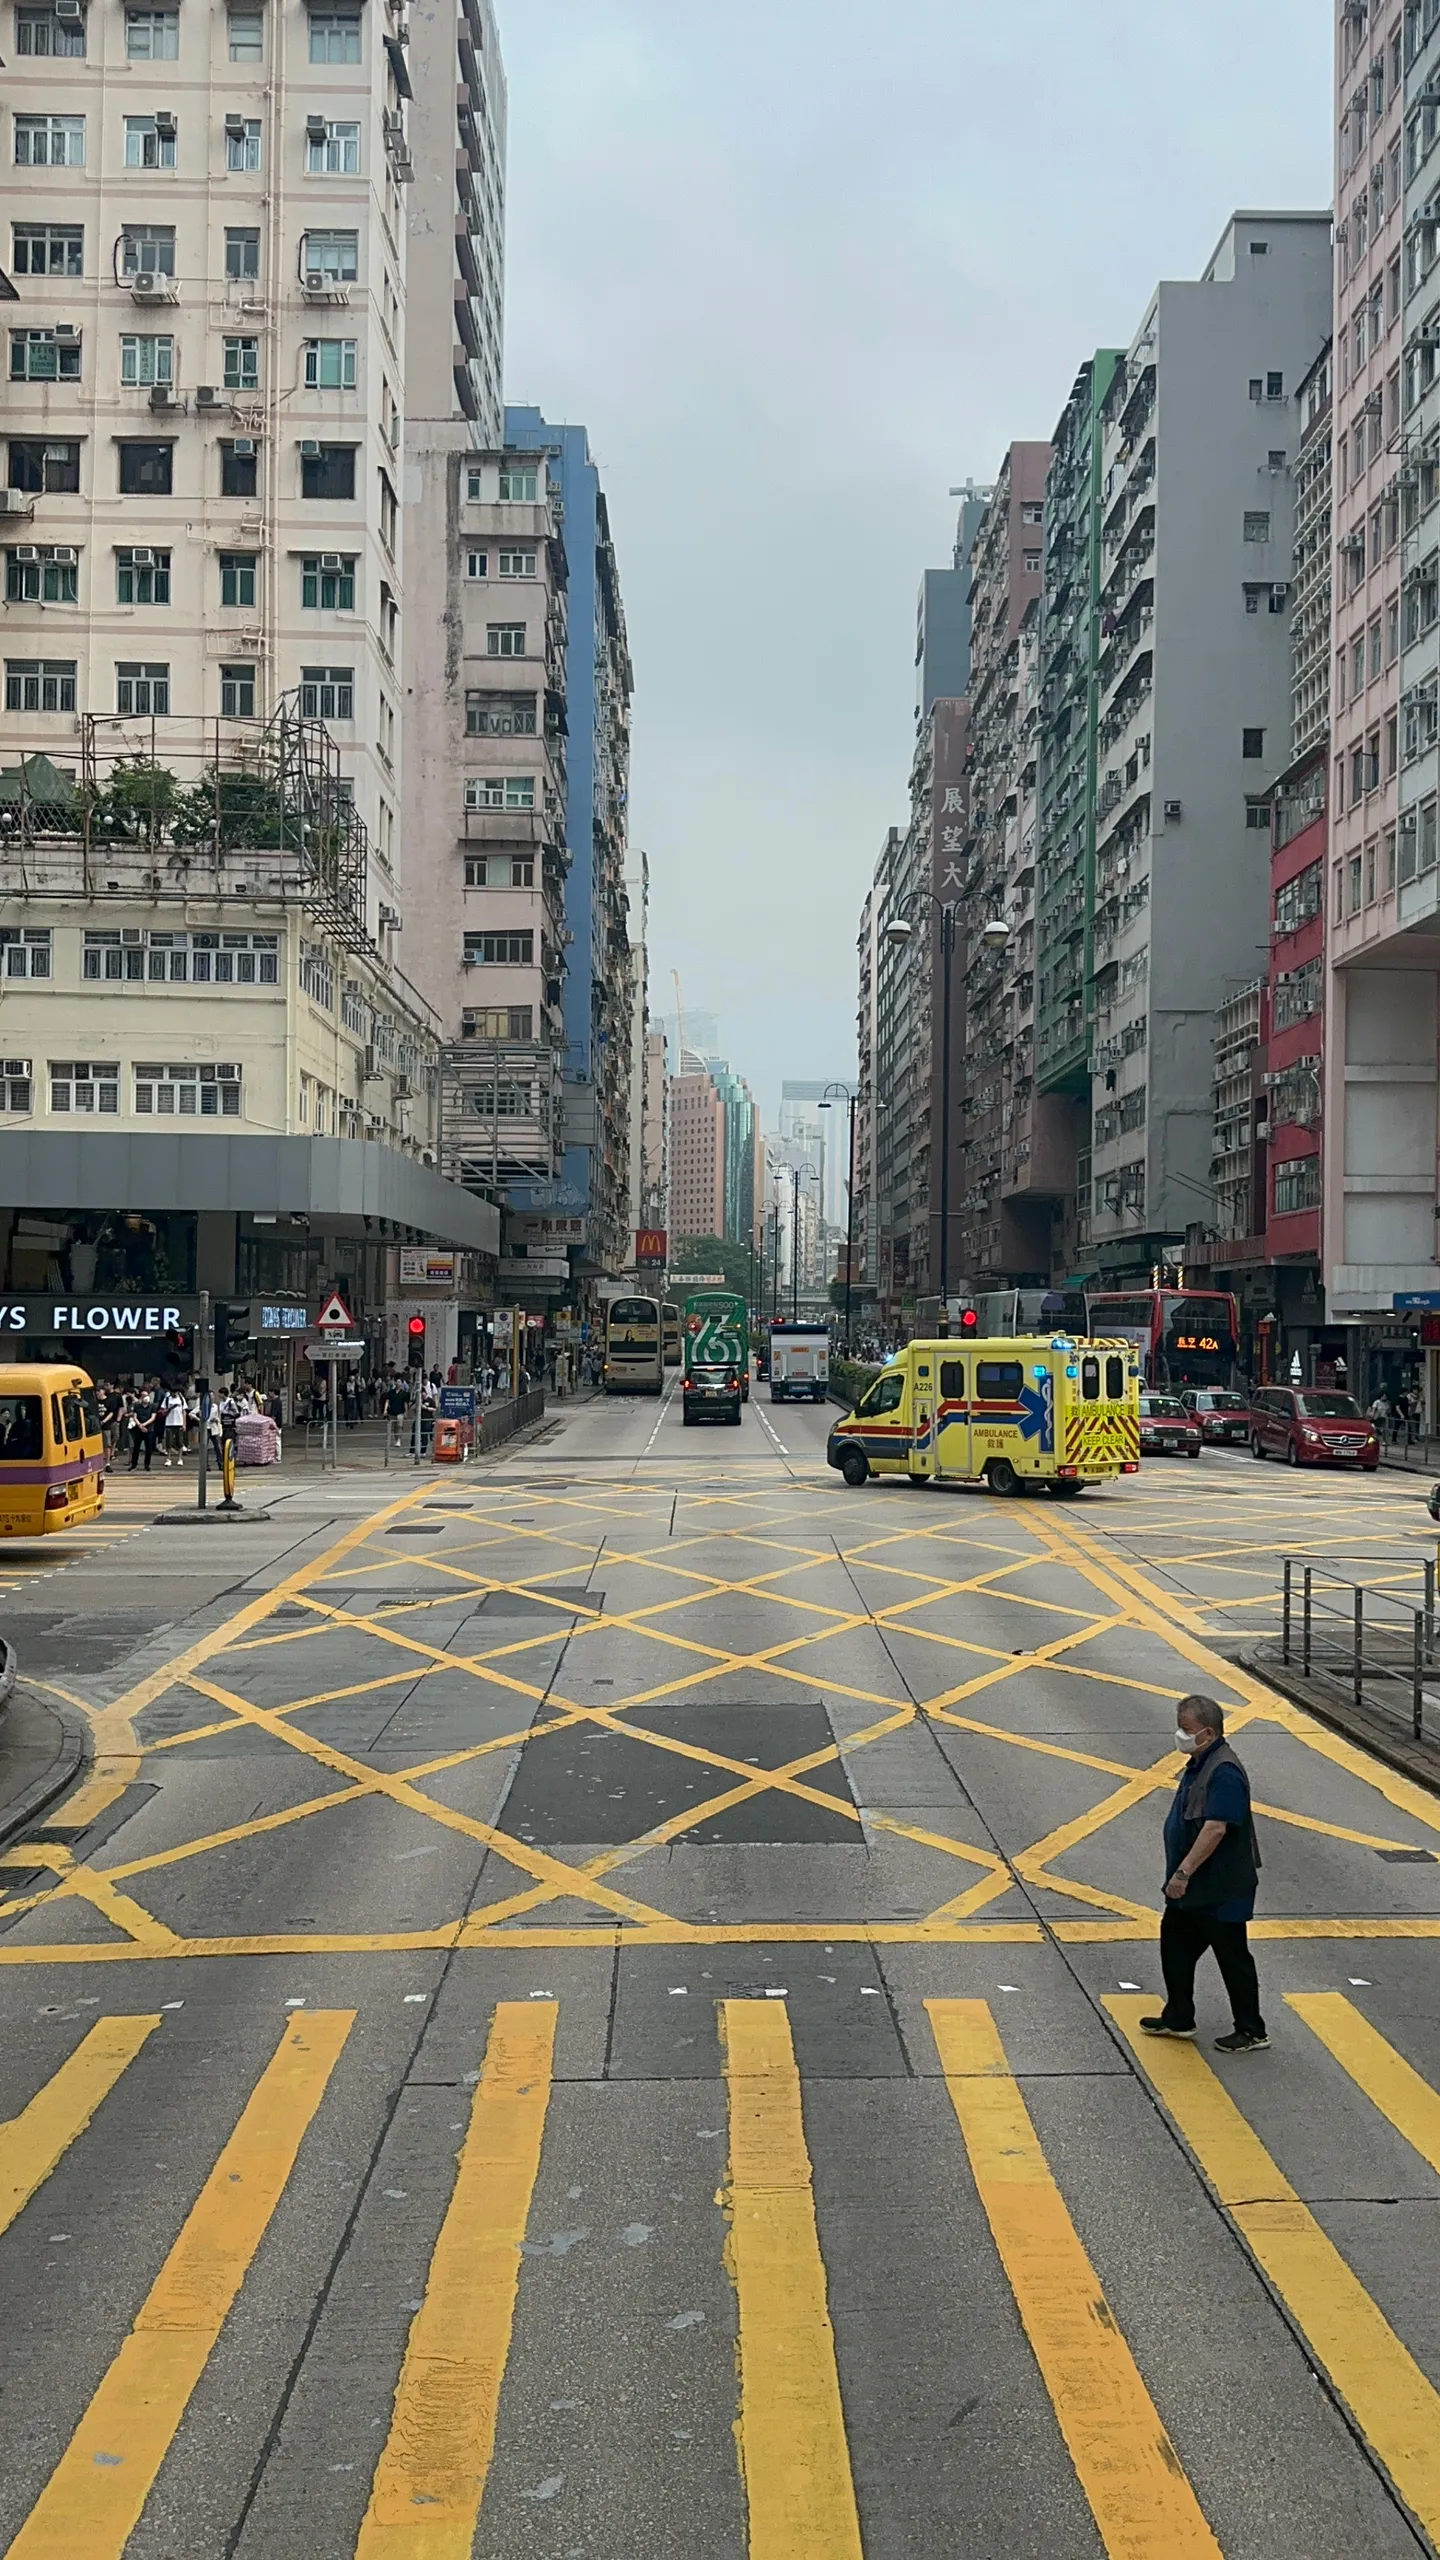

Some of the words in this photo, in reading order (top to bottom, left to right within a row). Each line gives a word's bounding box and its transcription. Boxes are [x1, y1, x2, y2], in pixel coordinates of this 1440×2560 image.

[719, 1301, 734, 1309] 500
[53, 1306, 180, 1330] FLOWER
[1199, 1337, 1219, 1350] 42A
[913, 1382, 933, 1391] A226
[1081, 1404, 1125, 1417] AMBULANCE
[973, 1429, 1018, 1439] AMBULANCE
[987, 1439, 1004, 1449] 救護
[1081, 1436, 1100, 1446] KEEP
[1102, 1434, 1124, 1445] CLEAR
